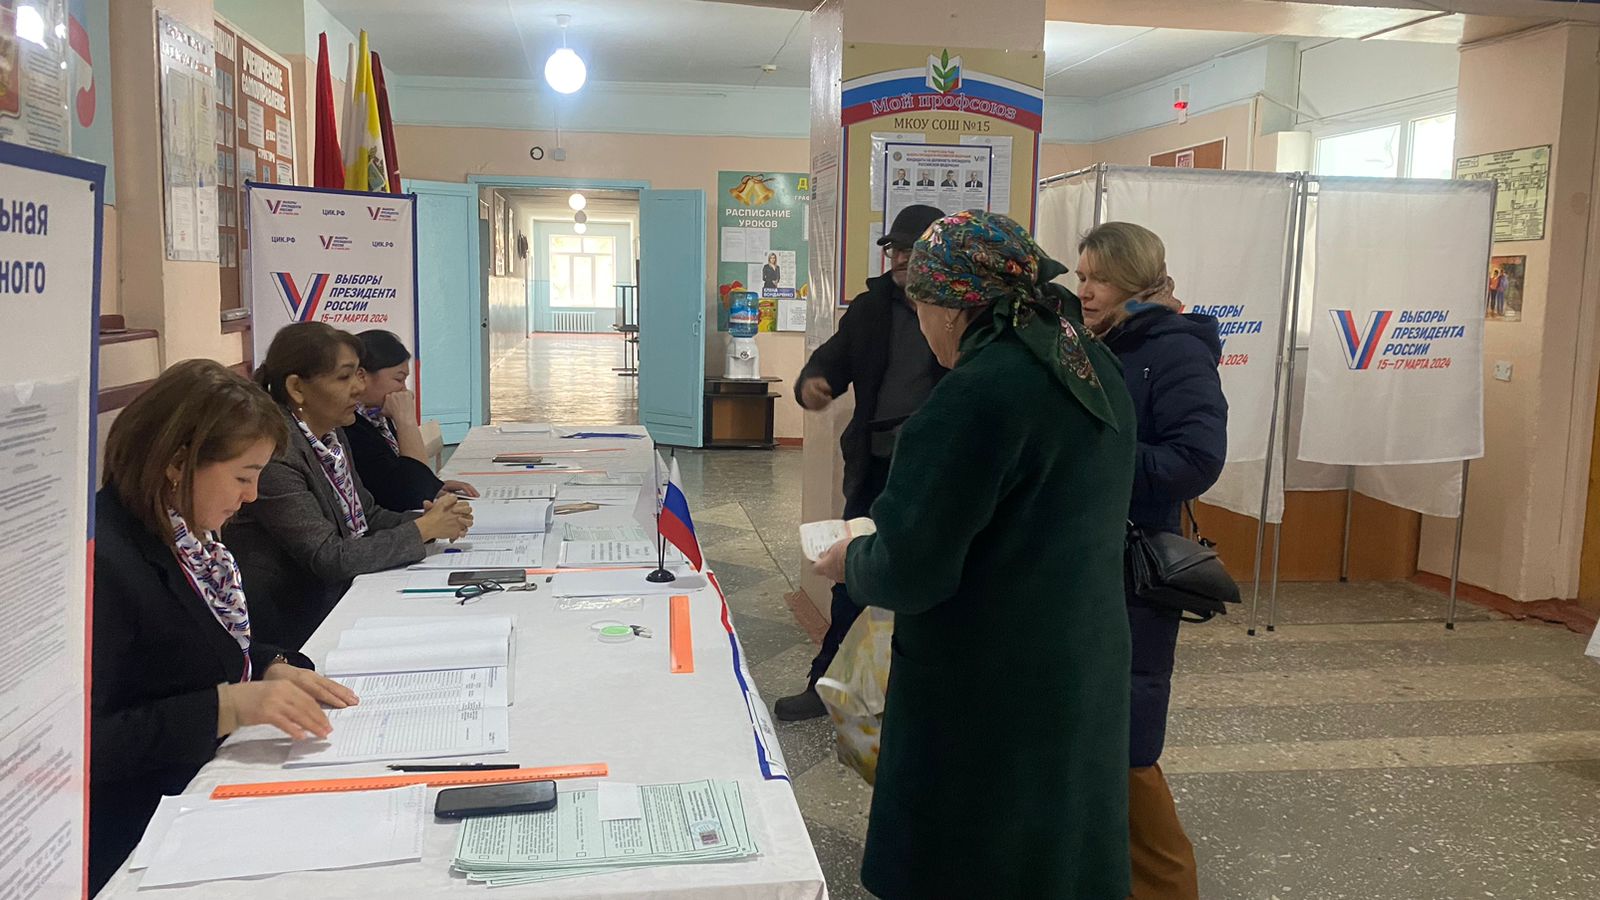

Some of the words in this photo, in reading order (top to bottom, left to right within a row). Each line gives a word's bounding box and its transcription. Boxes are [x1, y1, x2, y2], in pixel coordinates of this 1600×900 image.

[870, 92, 914, 115] Мой
[918, 92, 1017, 120] профсоюз
[894, 118, 928, 130] МКОУ
[931, 119, 959, 131] СОШ
[962, 120, 990, 131] №15
[725, 208, 791, 218] РАСПИСАНИЕ
[738, 219, 778, 228] УРОКОВ
[335, 274, 383, 285] ВЫБОРЫ
[329, 287, 397, 299] ПРЕЗИДЕНТА
[324, 301, 369, 311] РОССИИ
[1192, 305, 1245, 317] ВЫБОРЫ
[342, 313, 369, 322] МАРТА
[370, 314, 388, 322] 2024
[1399, 310, 1450, 323] ВЫБОРЫ
[1391, 325, 1465, 340] ПРЕЗИДЕНТА
[1382, 343, 1431, 356] РОССИИ
[1225, 354, 1248, 366] 2024
[1405, 359, 1429, 369] МАРТА
[1430, 358, 1452, 369] 2024
